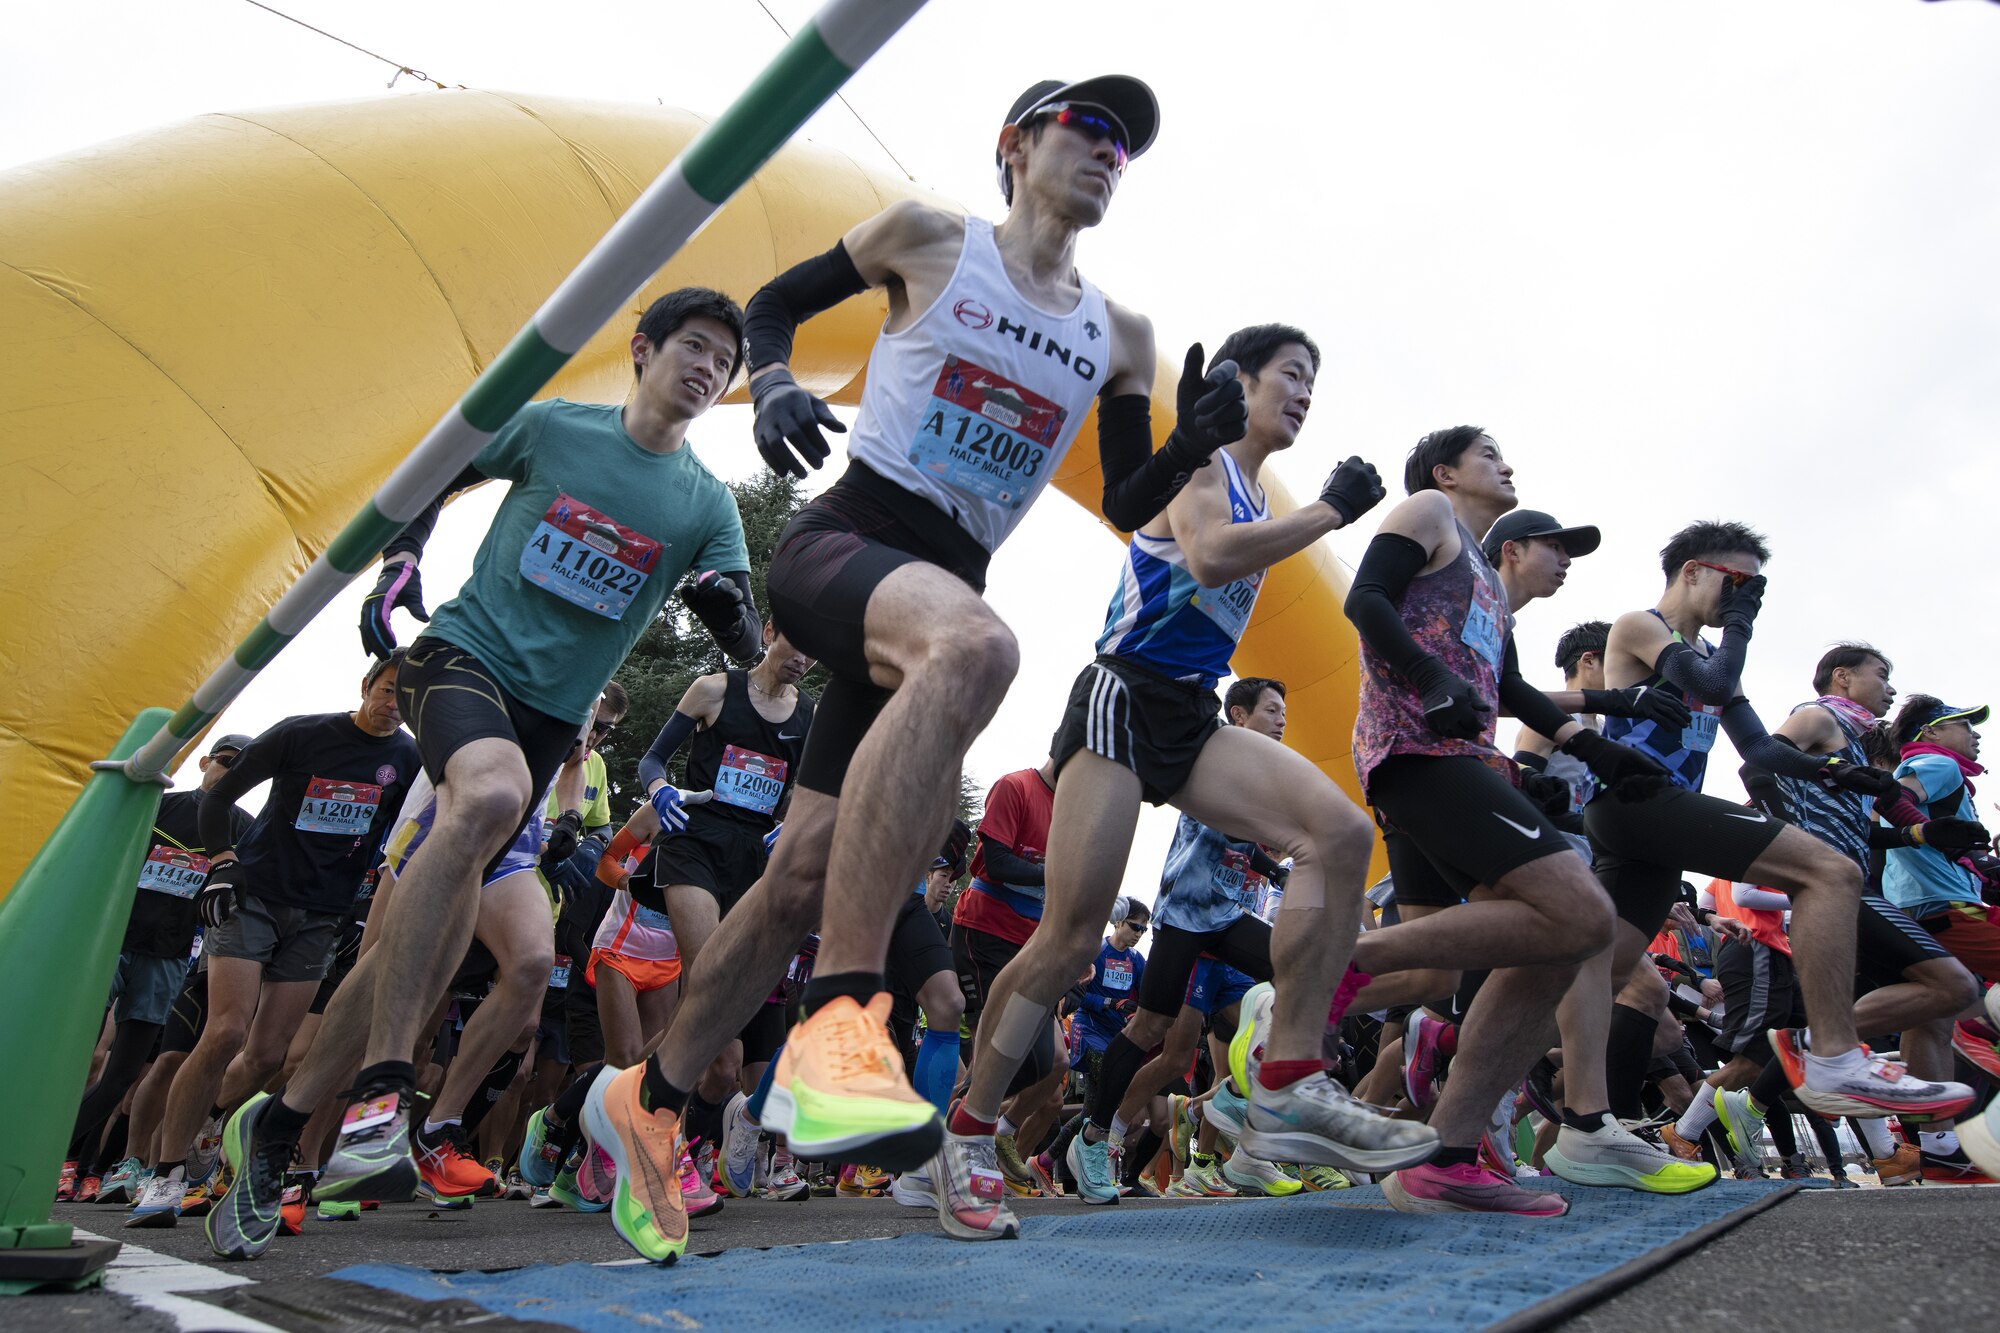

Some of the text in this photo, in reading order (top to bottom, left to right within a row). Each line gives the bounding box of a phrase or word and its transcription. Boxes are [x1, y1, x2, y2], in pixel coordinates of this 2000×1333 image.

[997, 316, 1096, 381] HINO
[923, 410, 945, 437] A
[954, 415, 1044, 478] 12003
[949, 446, 981, 466] HALF
[980, 461, 1013, 482] MALE
[531, 533, 551, 555] A
[556, 540, 642, 596] 11022
[551, 562, 579, 581] HALF
[579, 577, 609, 596] MALE
[720, 771, 781, 798] A 12009
[732, 786, 765, 801] HALF MALE
[303, 801, 375, 819] A 12018
[317, 815, 356, 825] HALF MALE
[143, 864, 153, 875] A
[156, 865, 205, 886] 14140
[154, 876, 187, 888] HALF MALE
